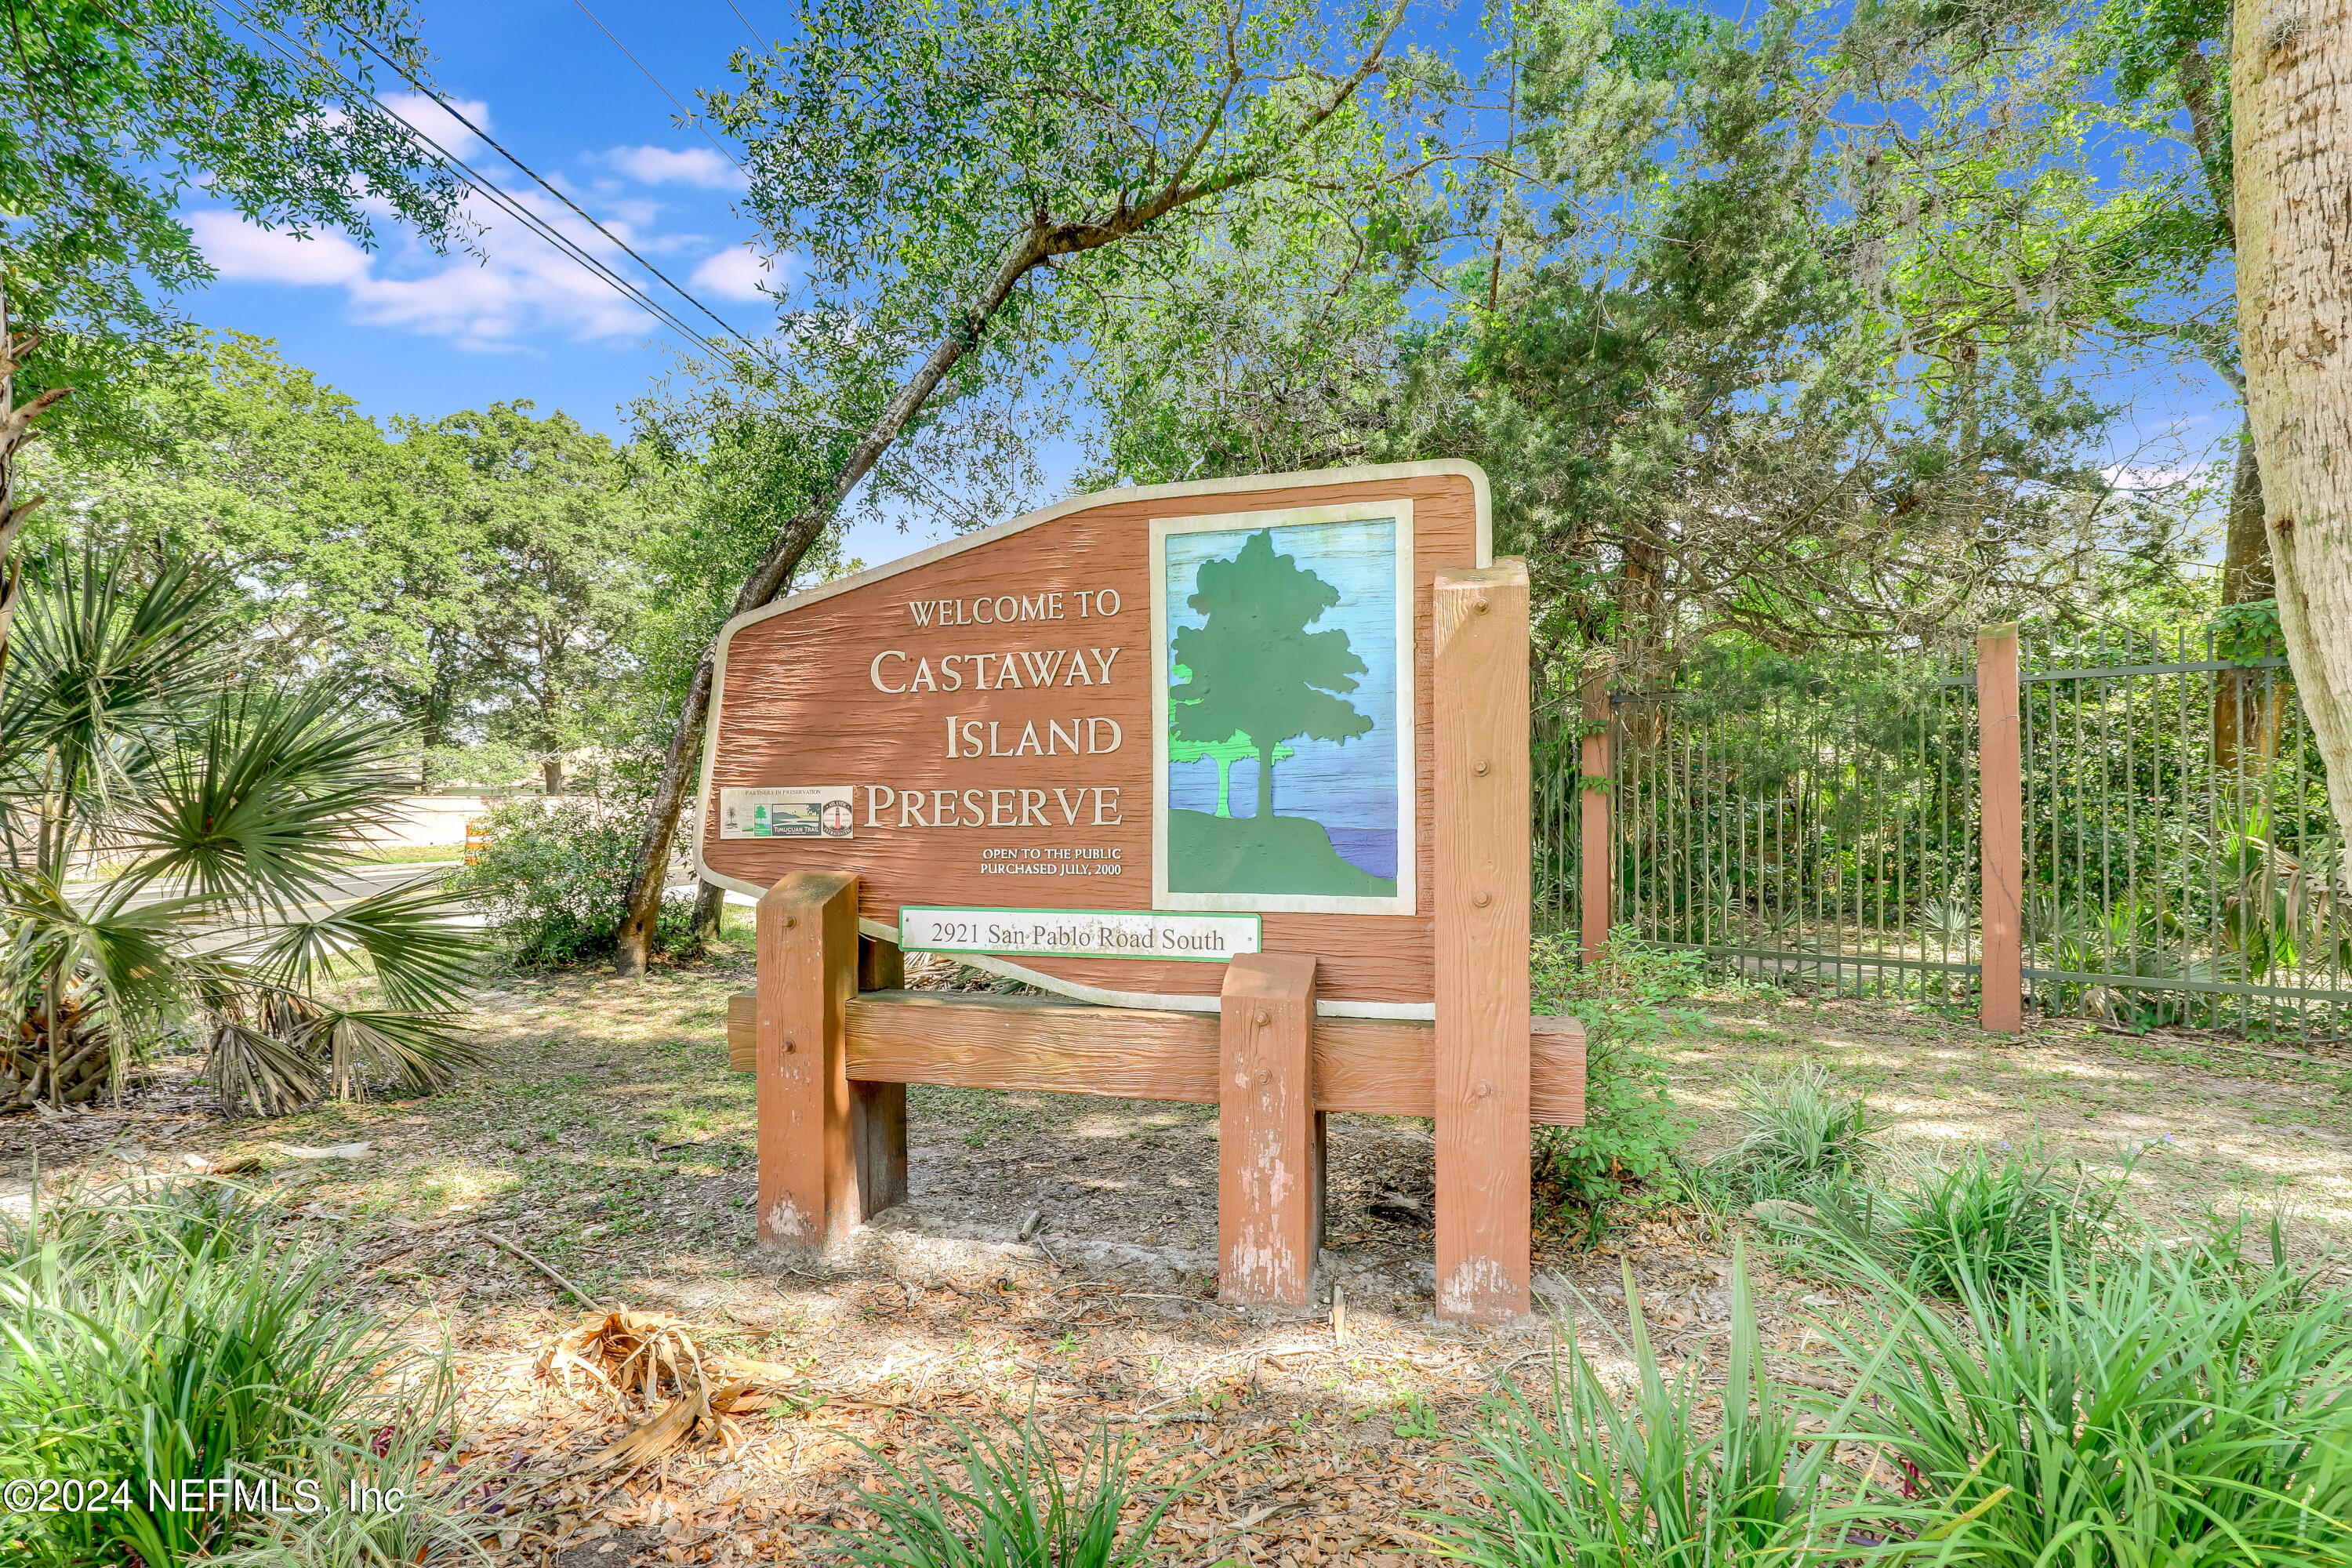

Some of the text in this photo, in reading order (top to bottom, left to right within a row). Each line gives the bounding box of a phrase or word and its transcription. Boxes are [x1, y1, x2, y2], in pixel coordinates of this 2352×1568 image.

[909, 589, 1121, 627] WELCOME TO
[870, 648, 1120, 694] CASTAWAY
[946, 716, 1123, 758] ISLAND
[863, 785, 1123, 828] PRESERVE
[980, 863, 1122, 877] PURCHASED JULY, 2000
[982, 848, 1121, 859] OPEN TO THE PUBLIC
[931, 923, 1225, 951] 2921 San Pablo Road South
